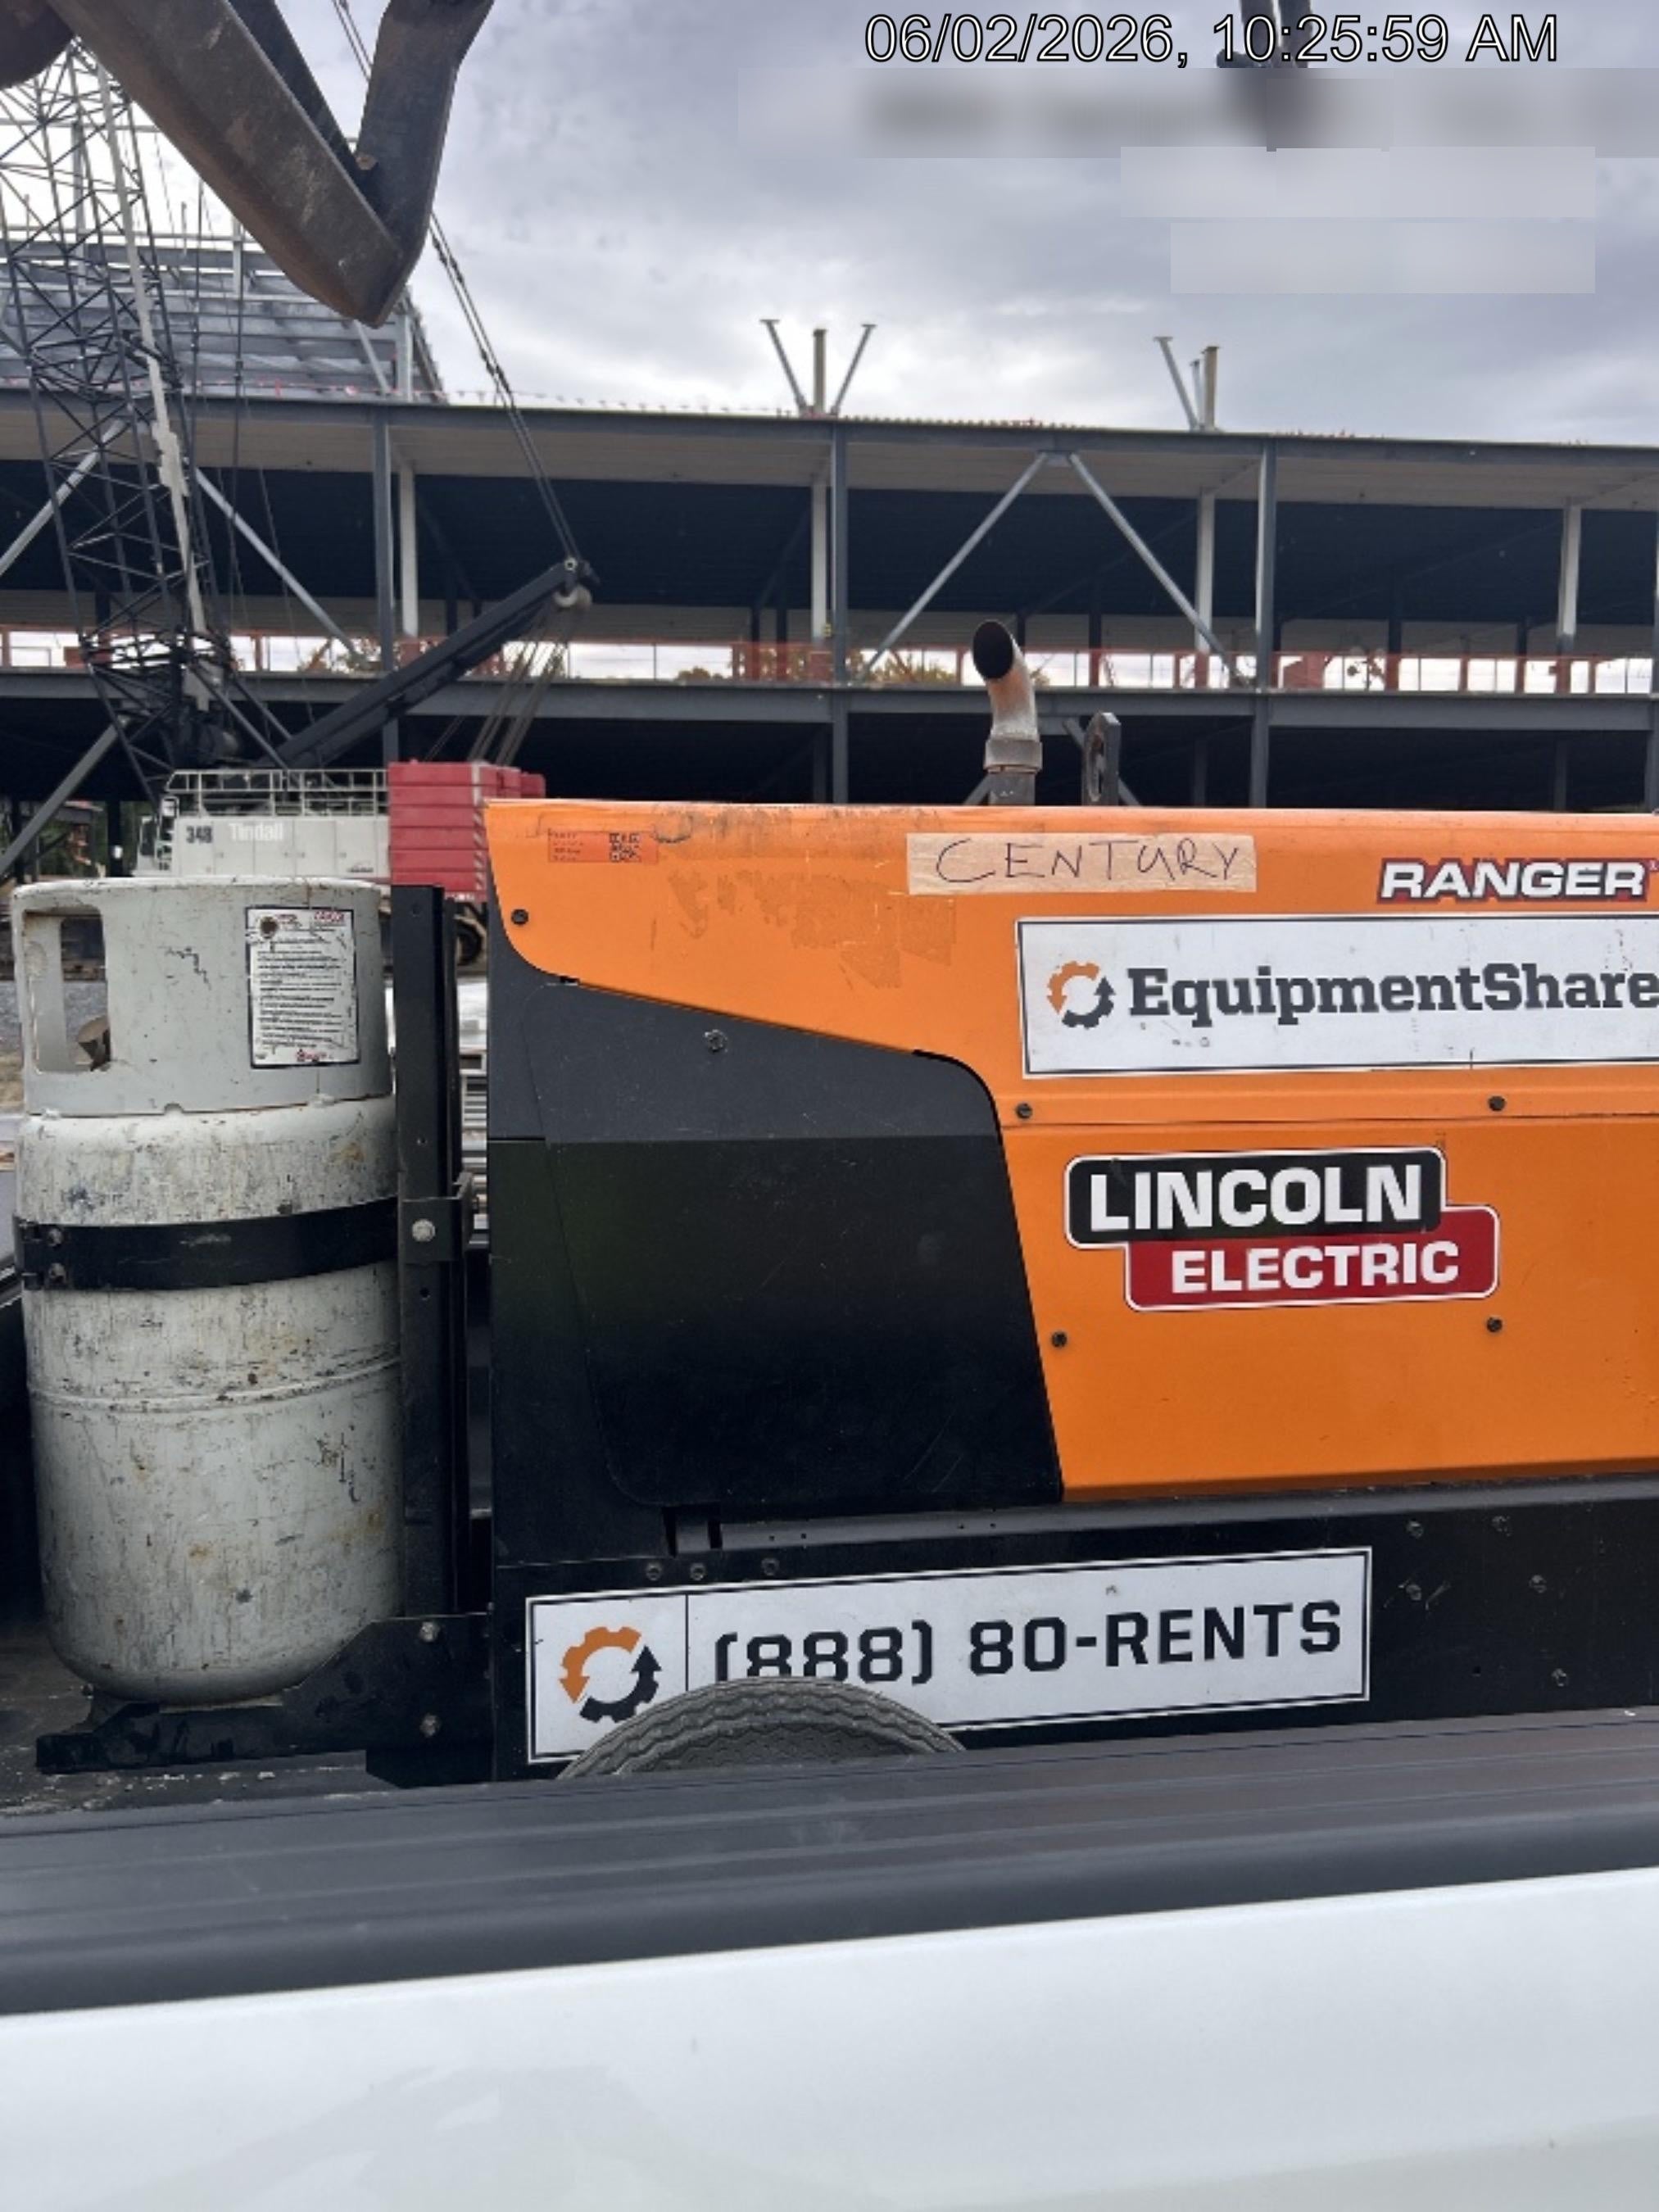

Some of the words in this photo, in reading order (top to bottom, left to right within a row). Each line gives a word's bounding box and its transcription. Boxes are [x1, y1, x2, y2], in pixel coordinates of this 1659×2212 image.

[936, 838, 1239, 882] CENTURY
[1380, 861, 1652, 899] RANGER
[1127, 963, 1659, 1027] EquipmentShare
[1090, 1165, 1421, 1232] LINCOLN
[1172, 1240, 1459, 1294] ELECTRIC
[714, 1619, 933, 1684] (888)
[969, 1600, 1342, 1675] 80-RENTS
